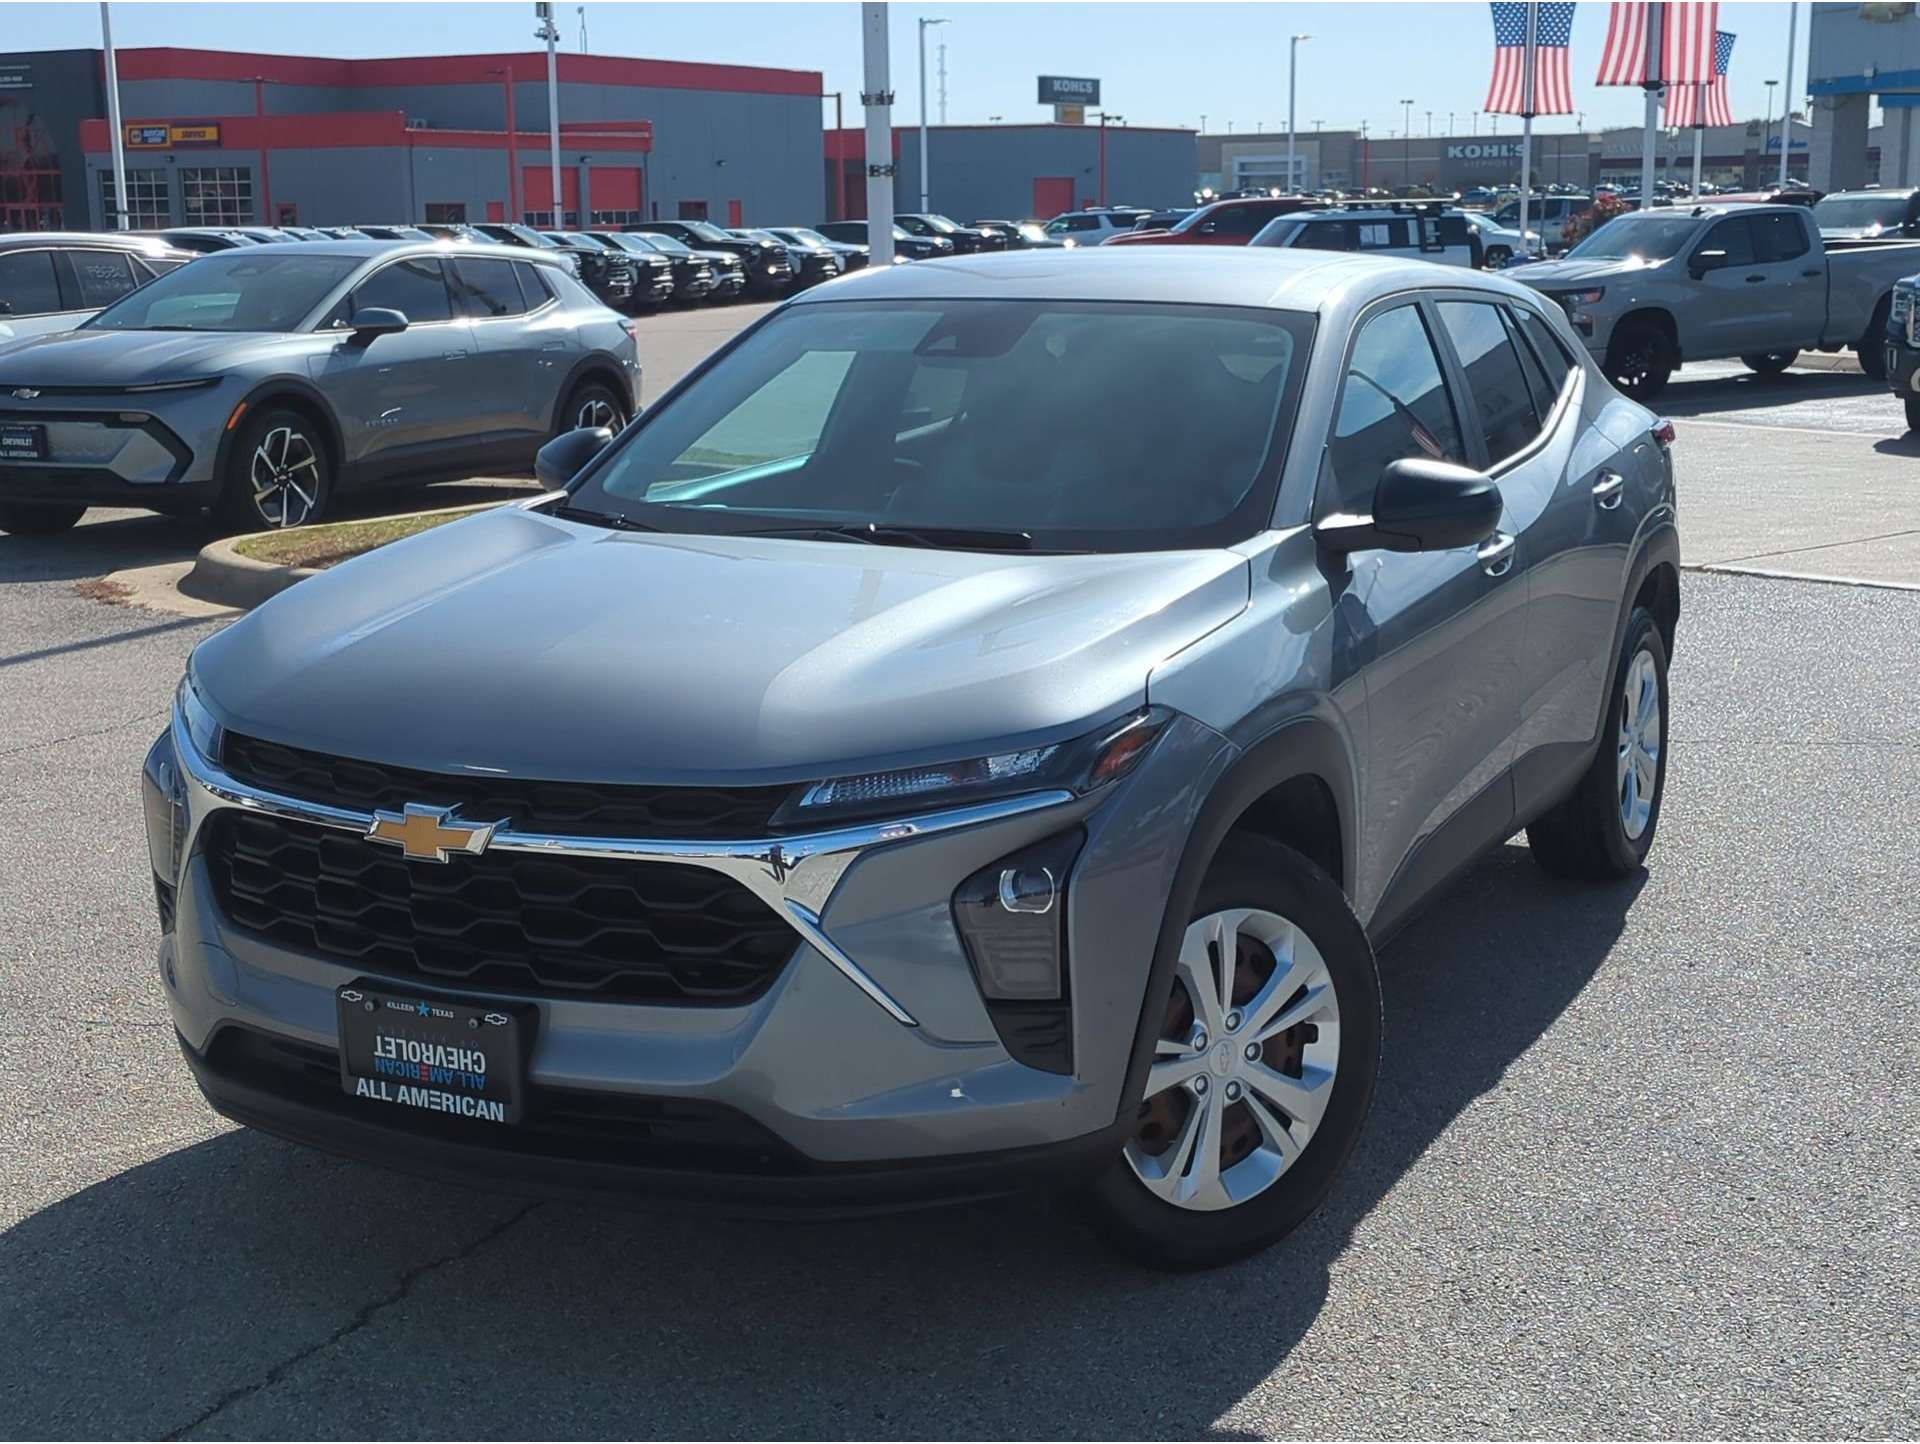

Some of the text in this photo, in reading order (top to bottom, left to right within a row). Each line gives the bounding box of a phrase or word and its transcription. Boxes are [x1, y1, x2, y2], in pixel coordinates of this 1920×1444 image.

[386, 1001, 454, 1018] KILLEEN TEXAS
[373, 1035, 486, 1074] CHEVROLET
[374, 1059, 487, 1090] ALL AMERICAN
[356, 1077, 504, 1123] ALL AMERICAN
